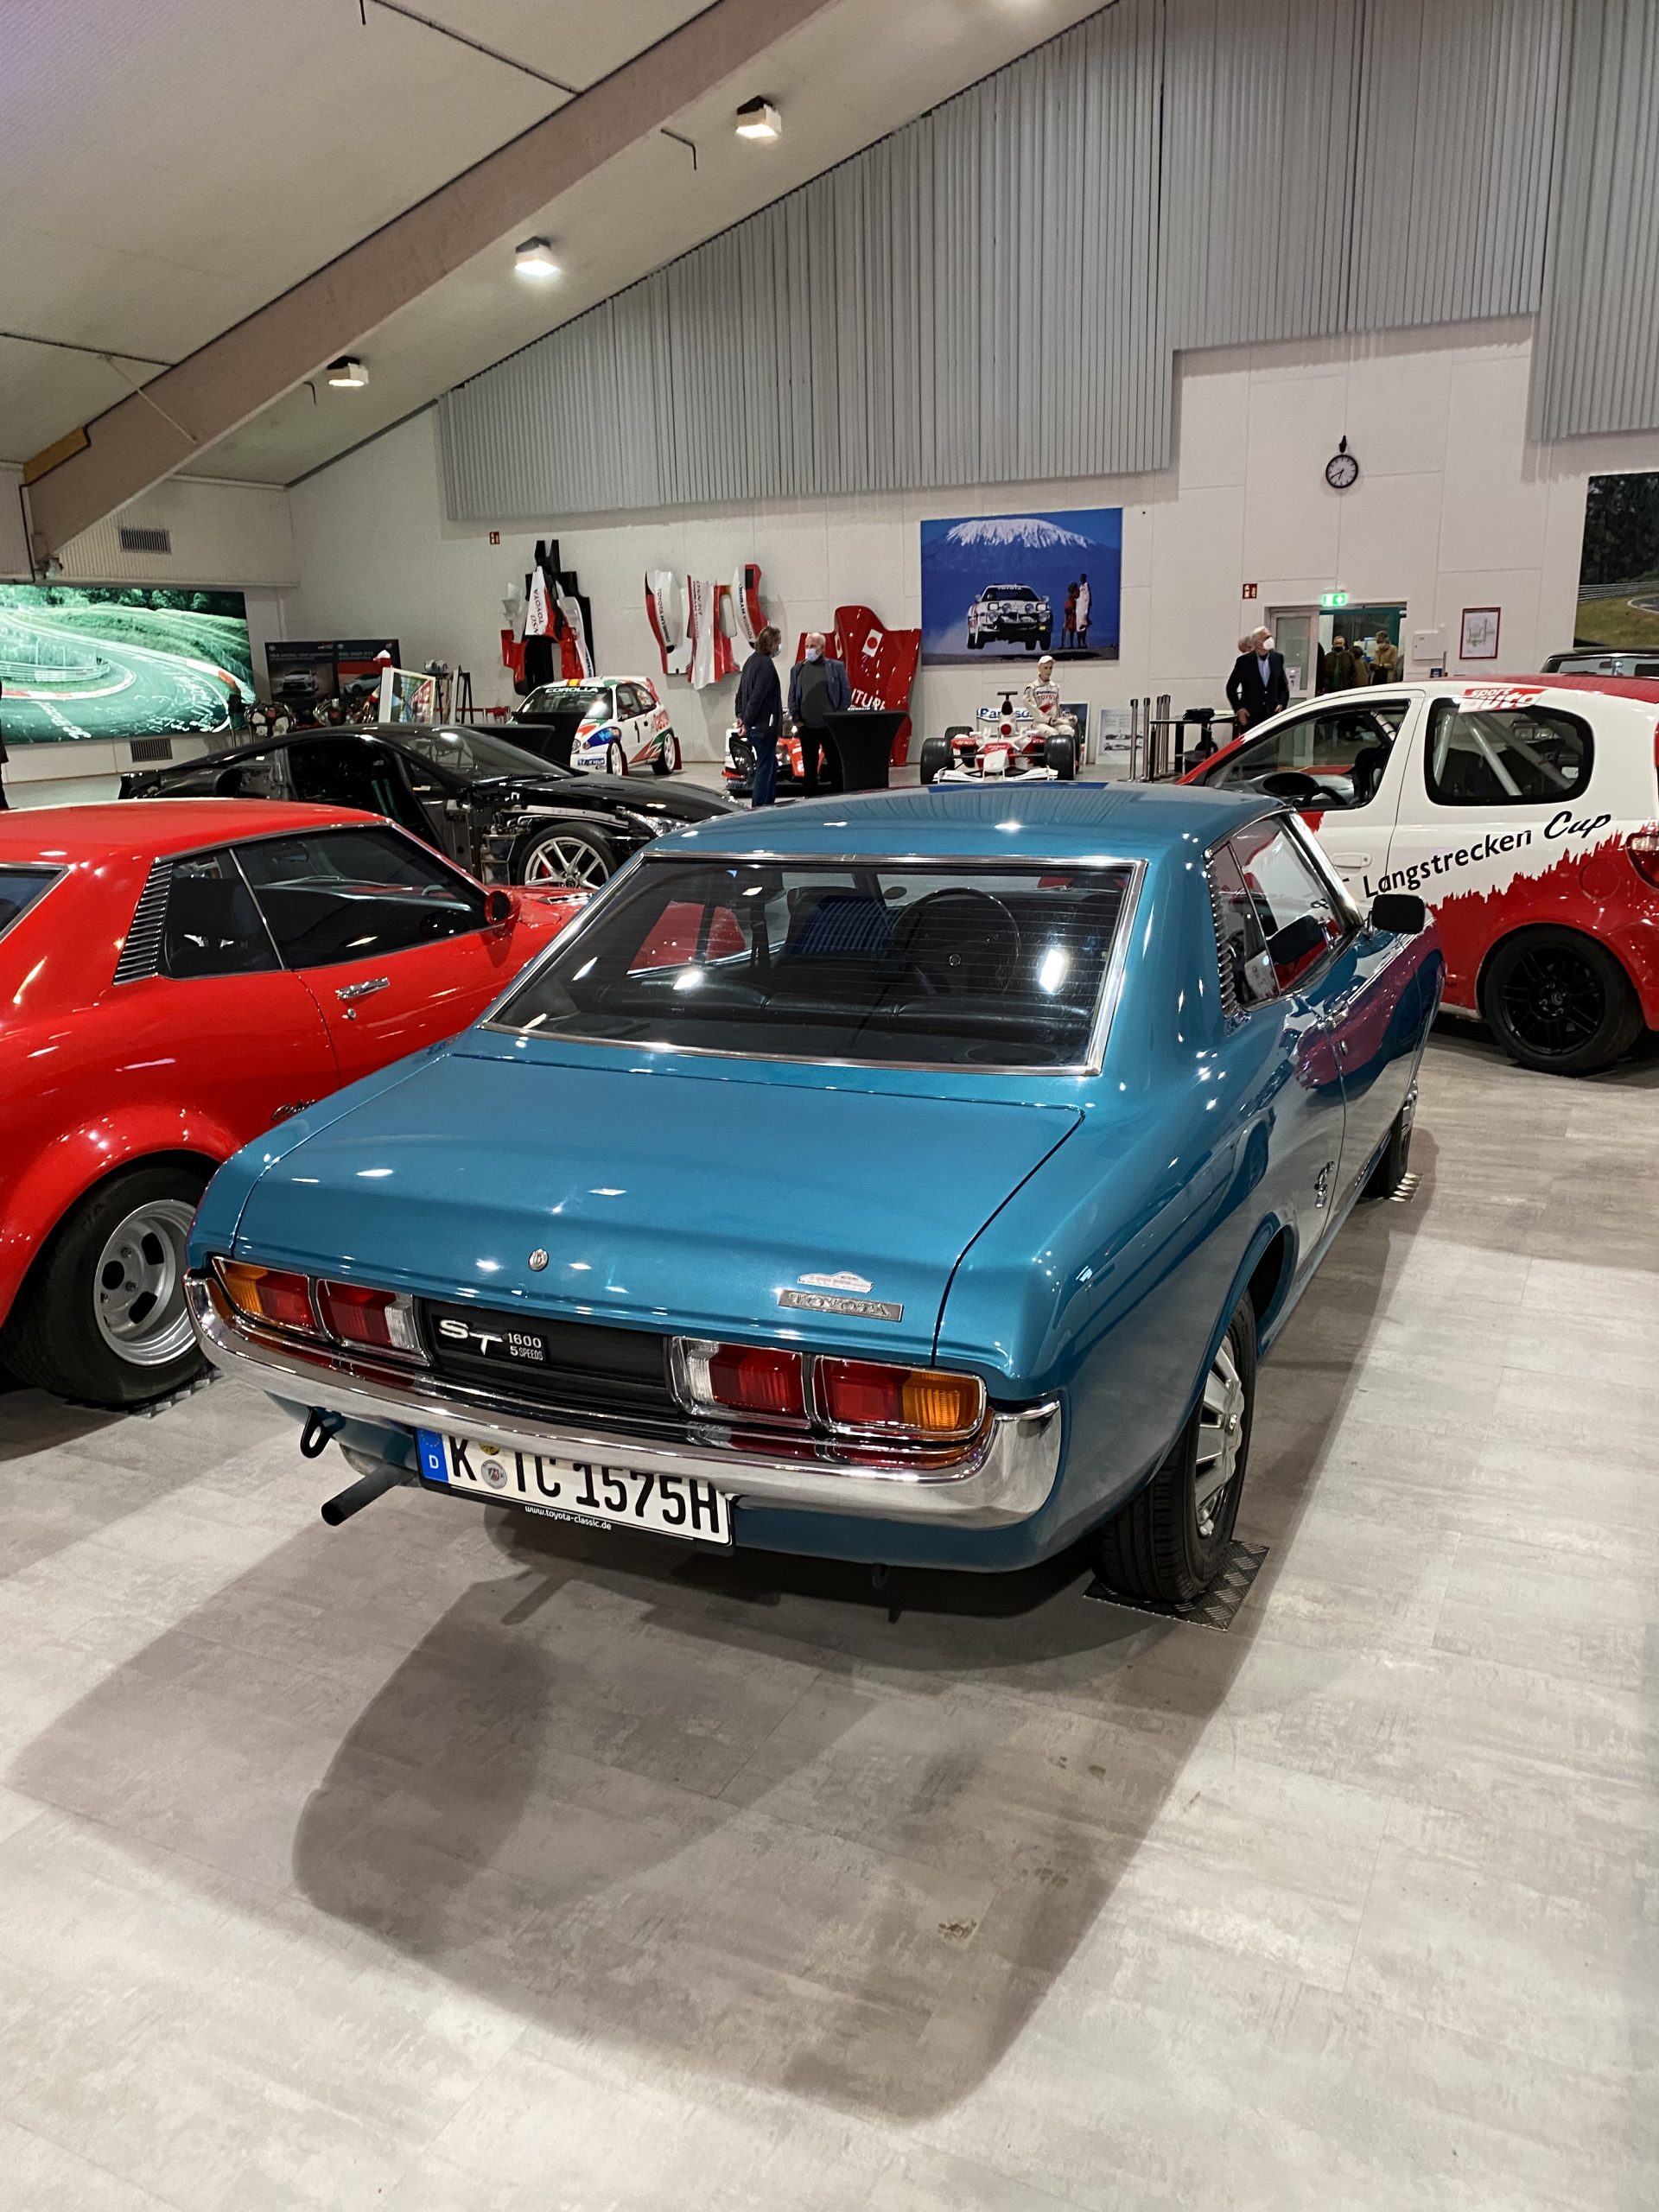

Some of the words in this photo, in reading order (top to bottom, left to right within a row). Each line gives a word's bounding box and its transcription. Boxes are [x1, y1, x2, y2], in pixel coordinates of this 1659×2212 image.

[533, 588, 544, 624] TOYOTA
[1470, 688, 1515, 699] sport
[1363, 830, 1532, 899] Langstrecken
[1543, 810, 1612, 840] Cup
[788, 1293, 892, 1319] TOYOTA
[508, 1332, 543, 1349] 1600
[510, 1345, 519, 1357] 5
[518, 1347, 543, 1362] SPEEDS
[429, 1455, 439, 1470] D
[449, 1436, 477, 1482] K
[573, 1462, 721, 1535] 1575H
[524, 1505, 613, 1530] www.toyota-classic.de
